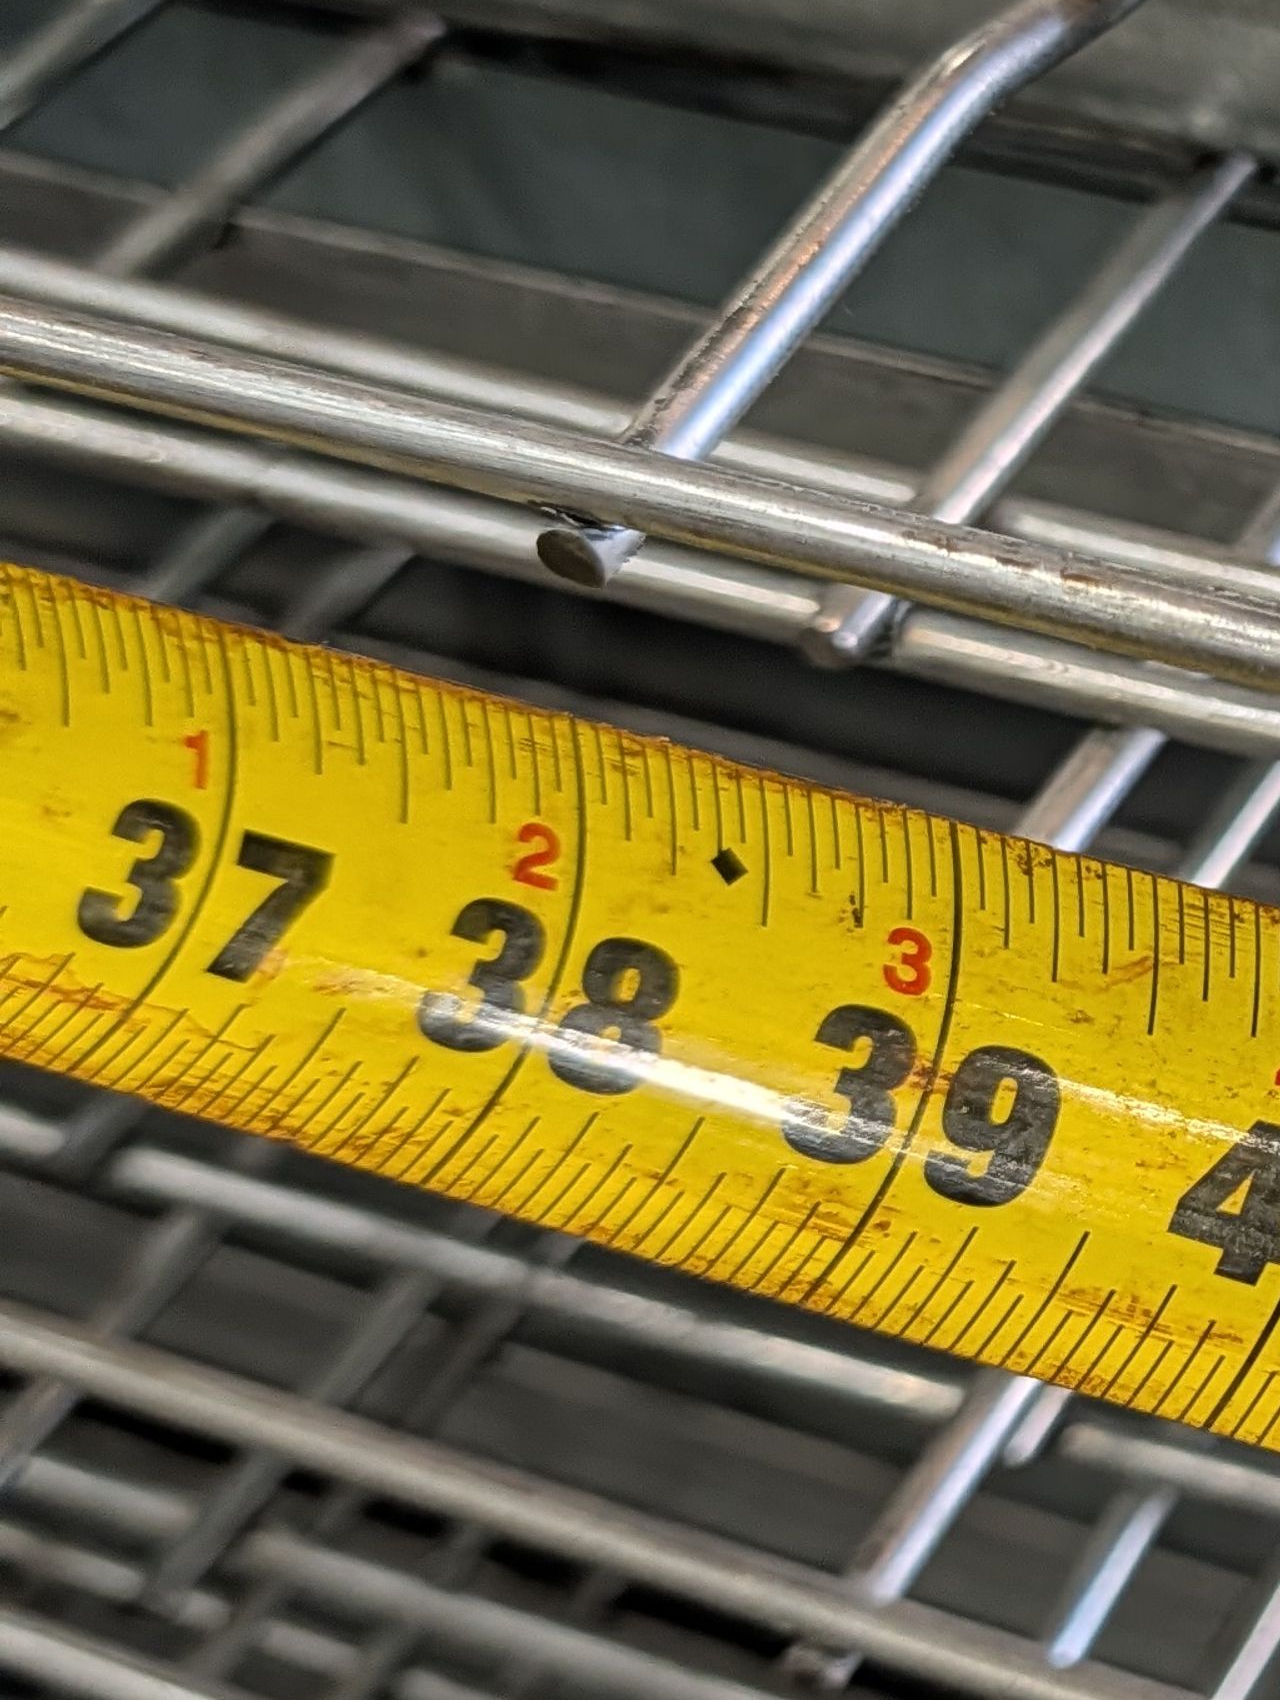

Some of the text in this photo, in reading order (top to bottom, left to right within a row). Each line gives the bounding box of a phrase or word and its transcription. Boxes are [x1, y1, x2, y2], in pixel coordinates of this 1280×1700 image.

[77, 798, 335, 983] 37
[416, 898, 679, 1094] 38
[781, 1004, 1061, 1207] 39
[184, 730, 208, 789] 1
[512, 822, 561, 890] 2
[882, 927, 932, 996] 3
